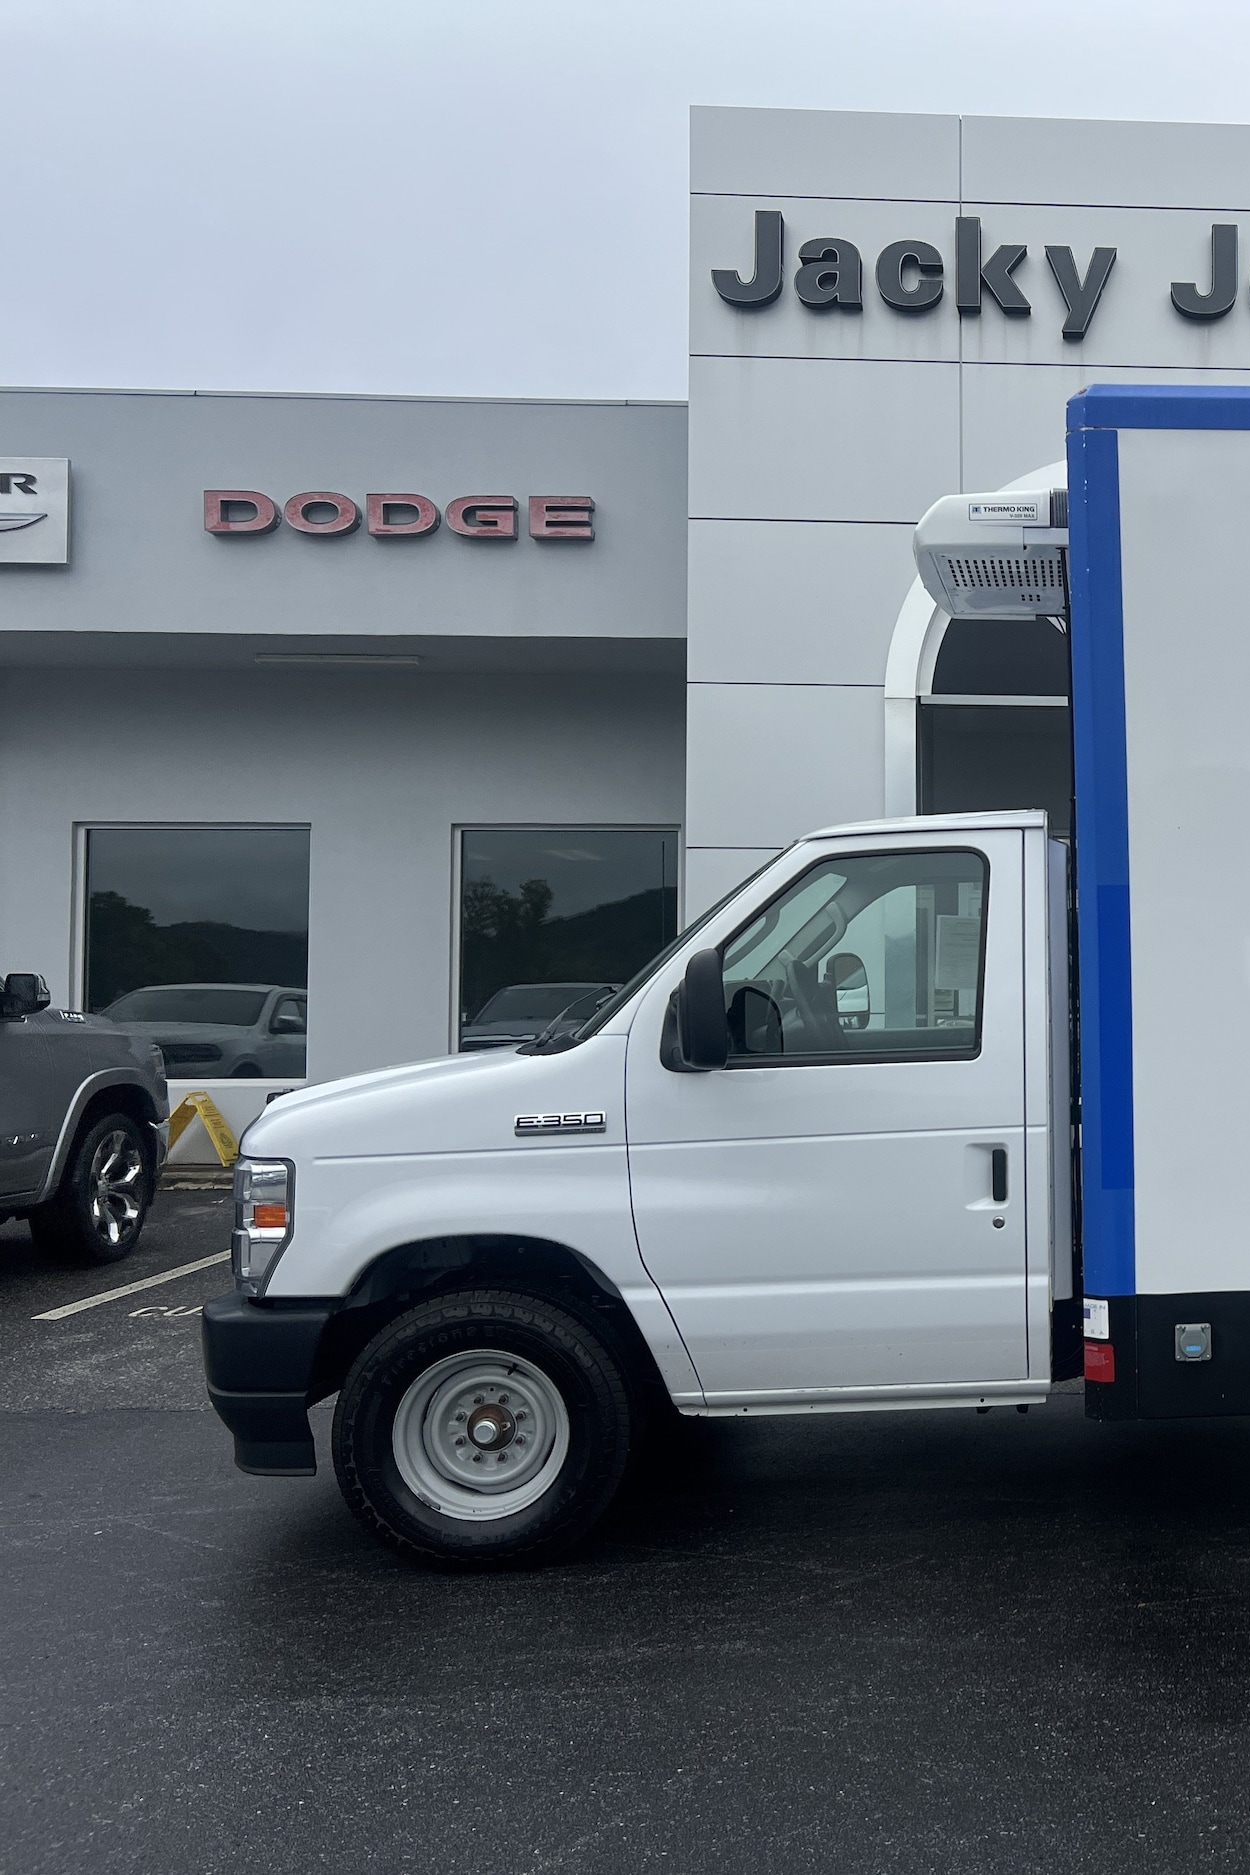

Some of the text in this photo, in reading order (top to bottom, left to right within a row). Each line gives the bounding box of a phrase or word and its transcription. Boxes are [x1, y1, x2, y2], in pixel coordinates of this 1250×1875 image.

[711, 210, 1117, 340] Jacky
[203, 489, 596, 541] DODGE
[515, 1112, 605, 1129] E-350
